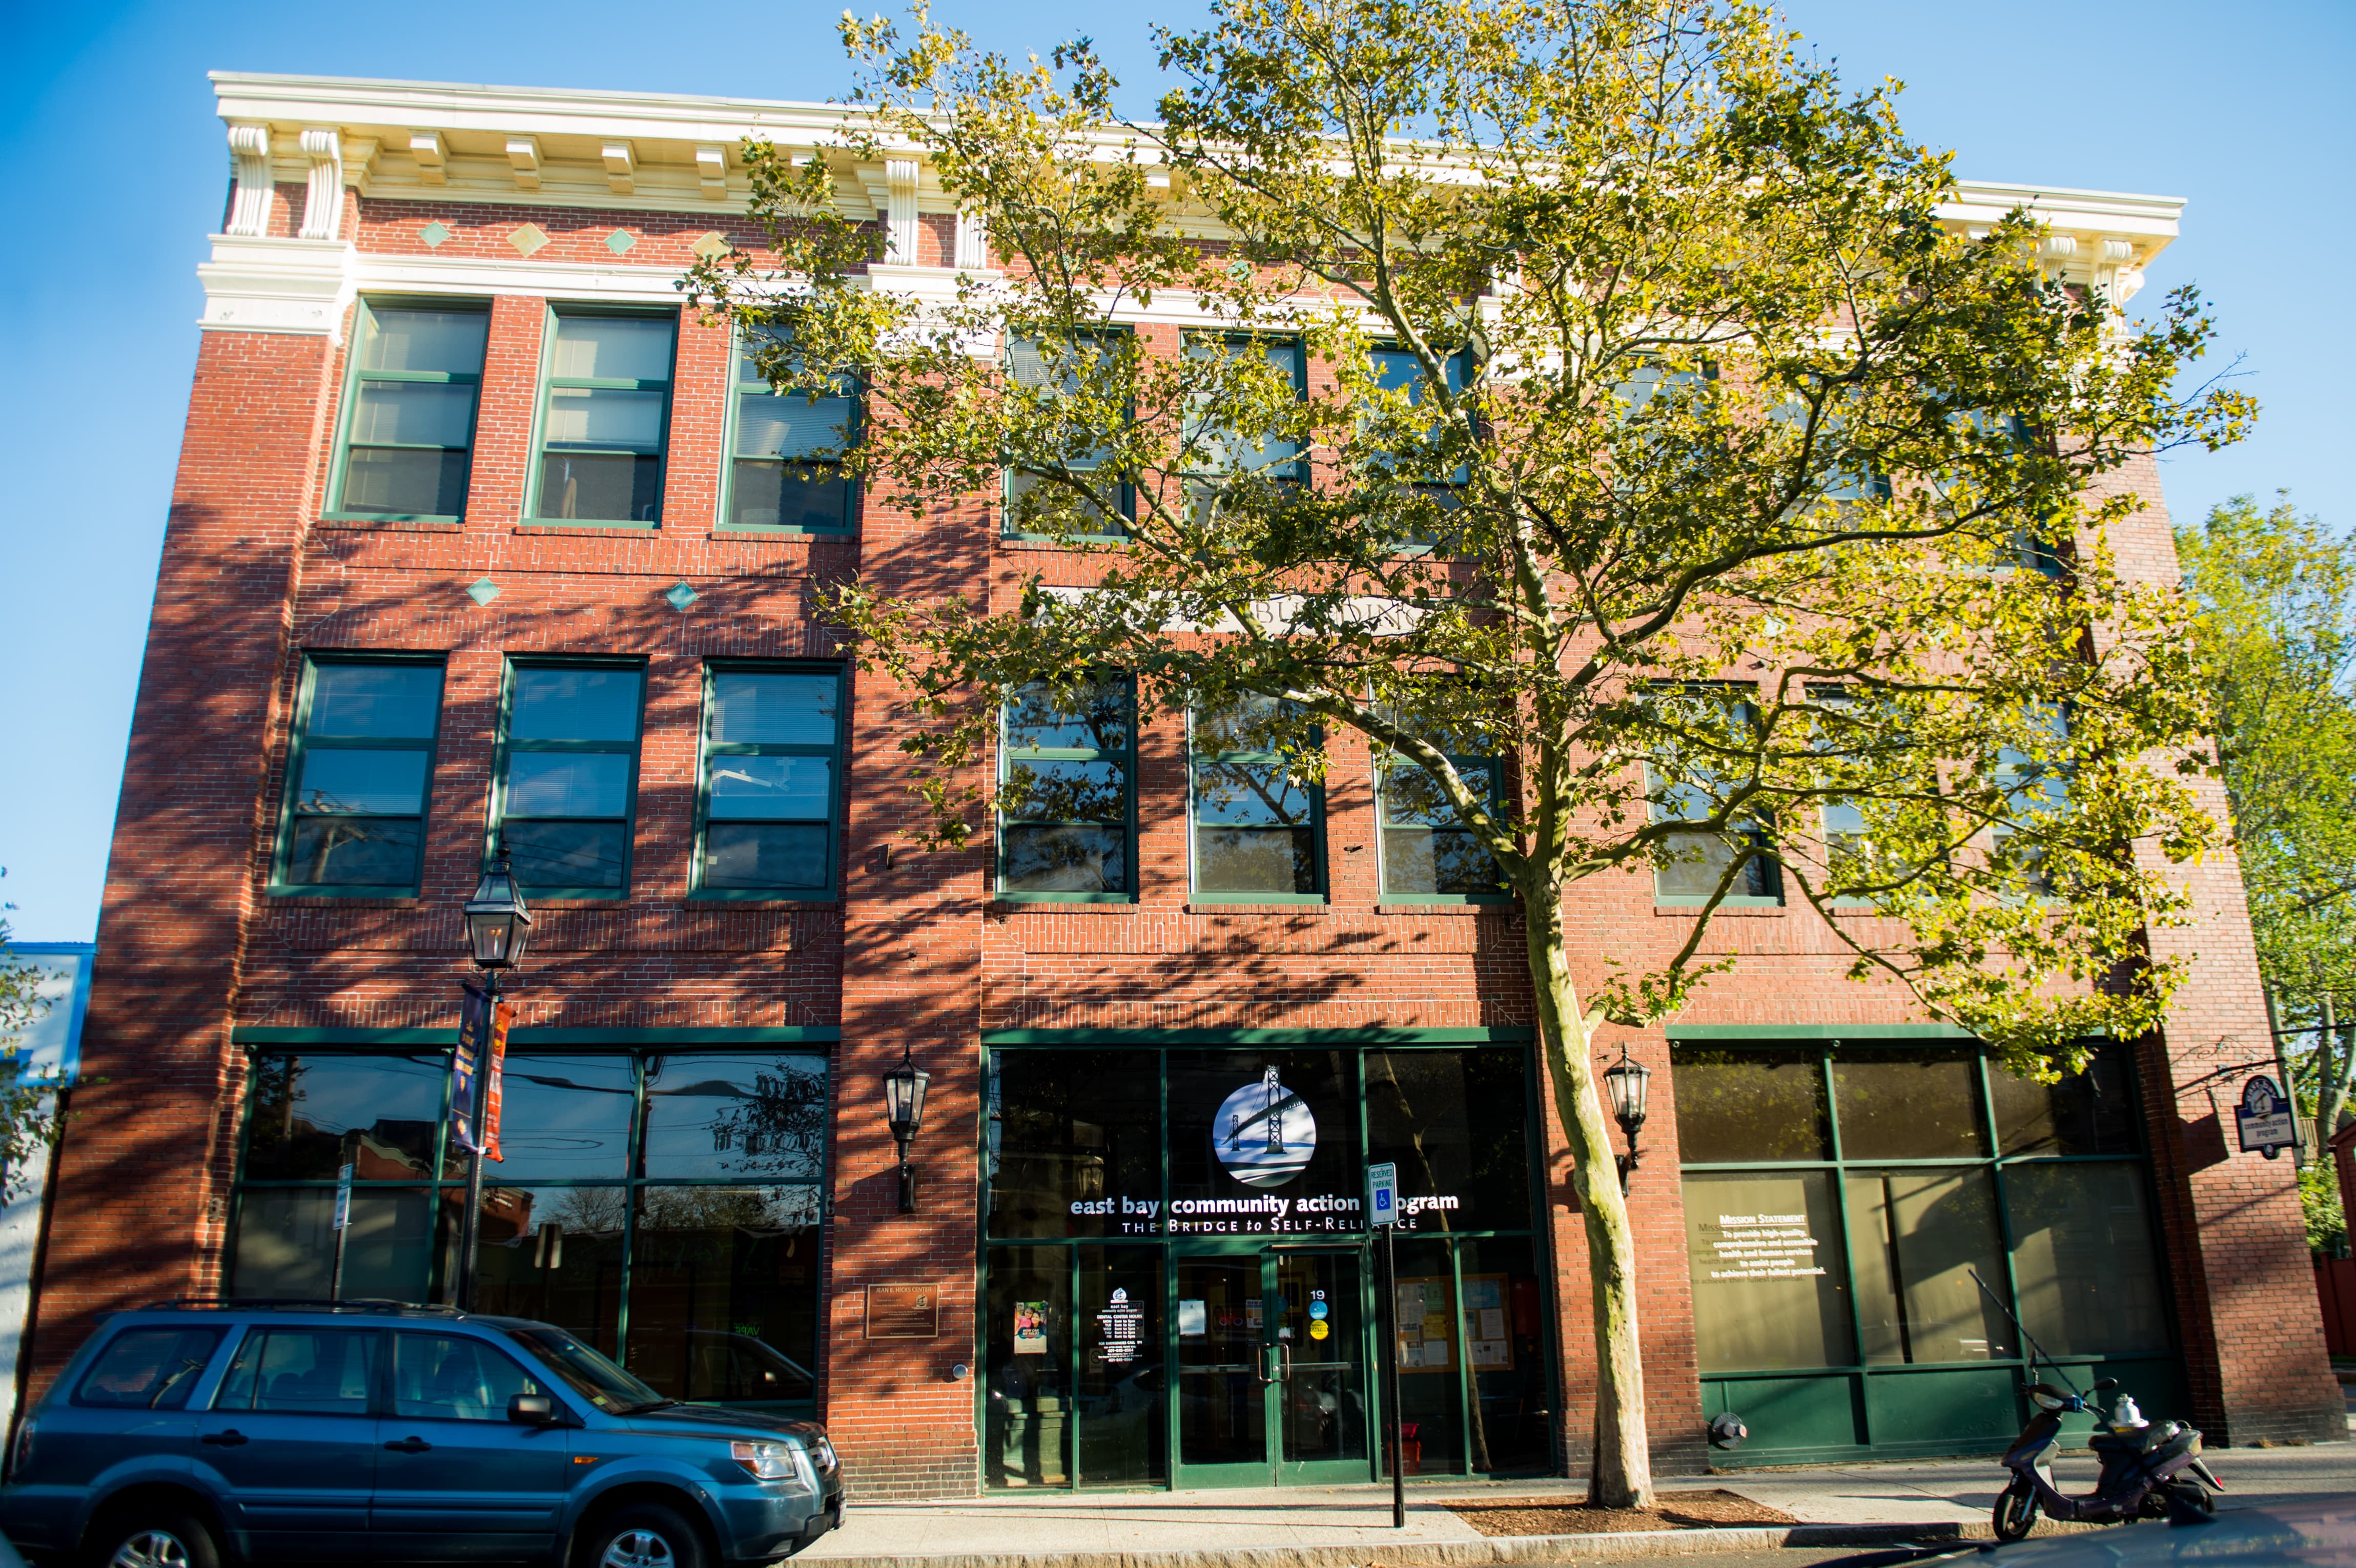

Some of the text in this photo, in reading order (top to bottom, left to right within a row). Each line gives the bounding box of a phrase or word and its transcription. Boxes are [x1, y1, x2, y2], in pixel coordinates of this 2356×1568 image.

[2244, 1118, 2288, 1130] community action
[2257, 1128, 2278, 1138] program
[1371, 1169, 1392, 1179] RESERVED
[1372, 1179, 1392, 1189] PARKING
[1071, 1193, 1459, 1219] east bay community action ogram
[1122, 1216, 1417, 1232] THE BRIDGE to SELF-RELICE
[1733, 1230, 1761, 1239] provide
[1761, 1228, 1807, 1239] high-quality,
[1713, 1240, 1767, 1249] comprehensive
[1783, 1238, 1818, 1246] accessible
[1719, 1249, 1743, 1257] health
[1749, 1258, 1769, 1267] assist
[1770, 1258, 1795, 1267] people
[1720, 1269, 1748, 1277] achieve
[1748, 1269, 1767, 1277] their
[1767, 1268, 1791, 1276] fullest
[1791, 1266, 1827, 1276] potential.
[1310, 1290, 1325, 1300] 19
